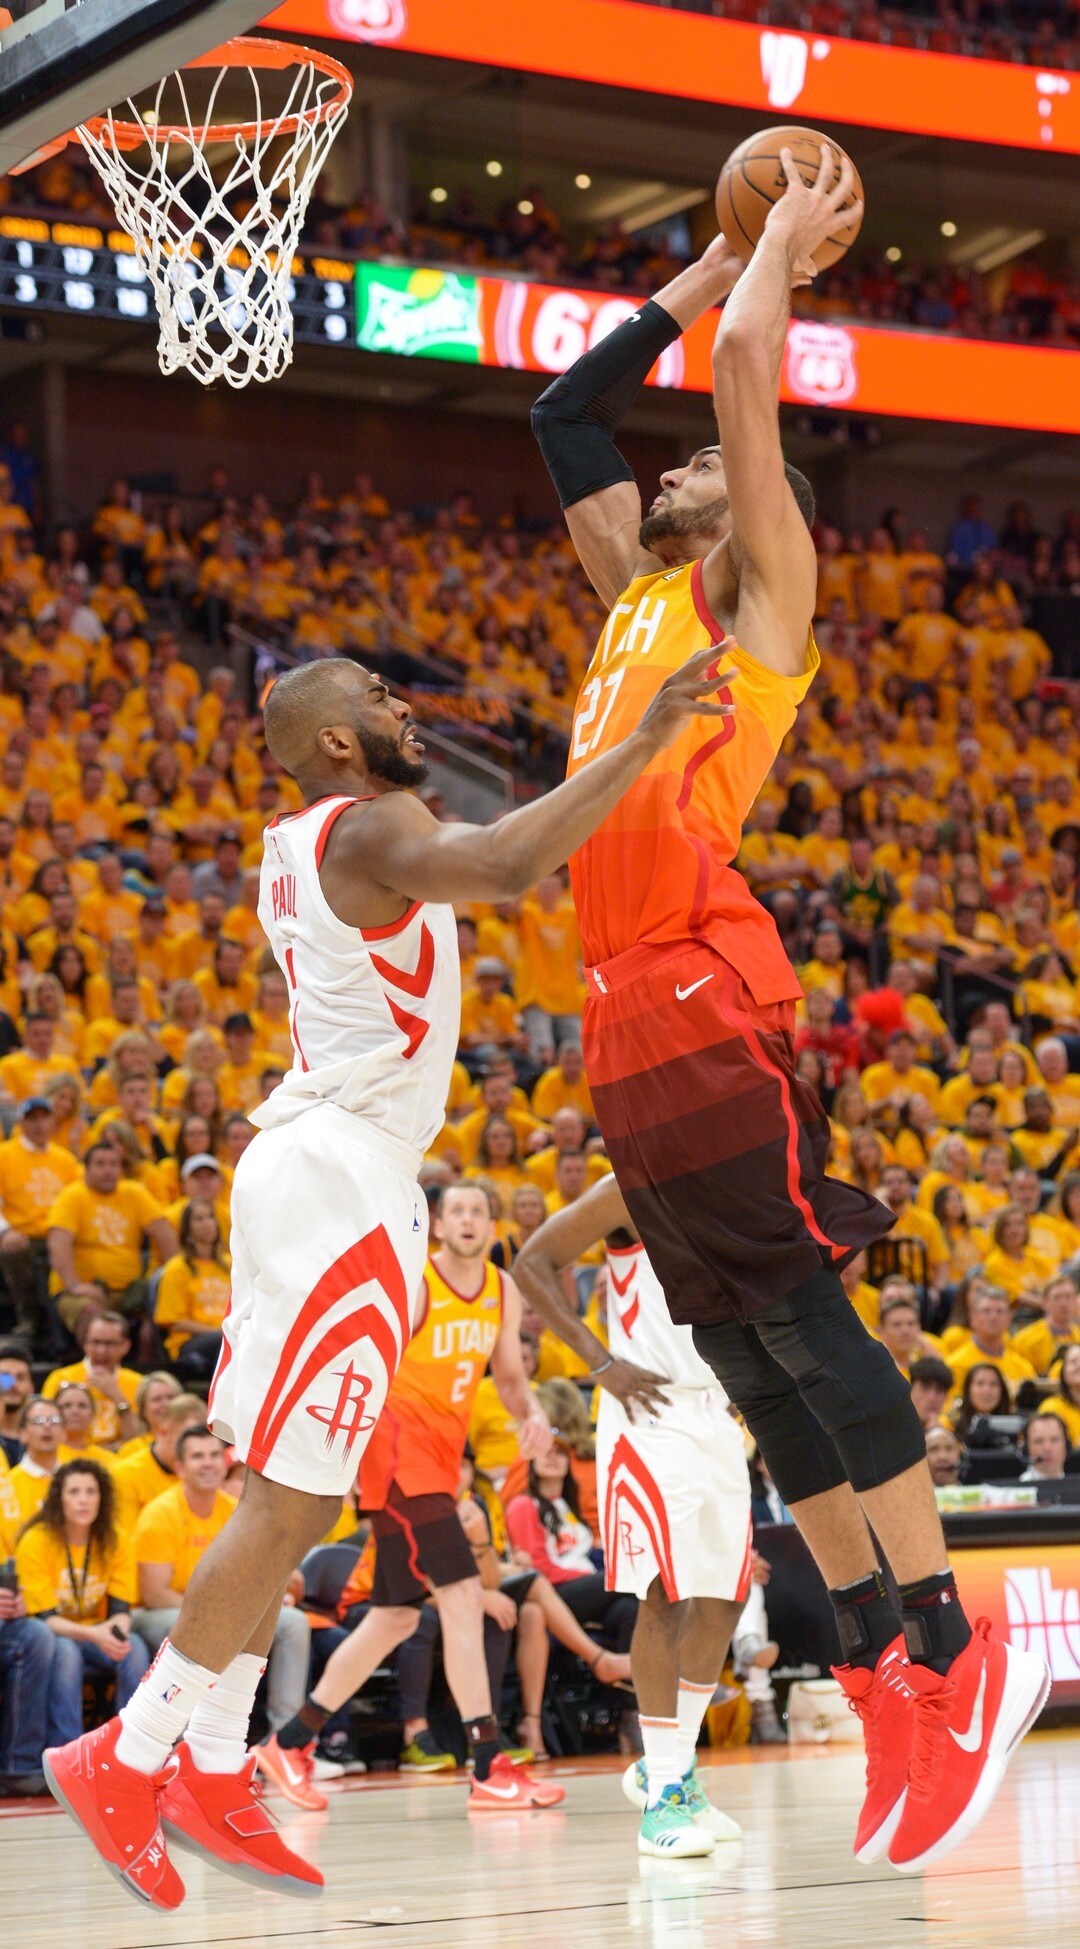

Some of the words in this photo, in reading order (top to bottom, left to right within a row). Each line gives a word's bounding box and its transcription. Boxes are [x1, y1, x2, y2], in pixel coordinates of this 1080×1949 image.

[572, 667, 626, 760] 27
[271, 873, 298, 922] PAUL
[432, 1318, 497, 1359] UTAH
[451, 1360, 474, 1403] 2
